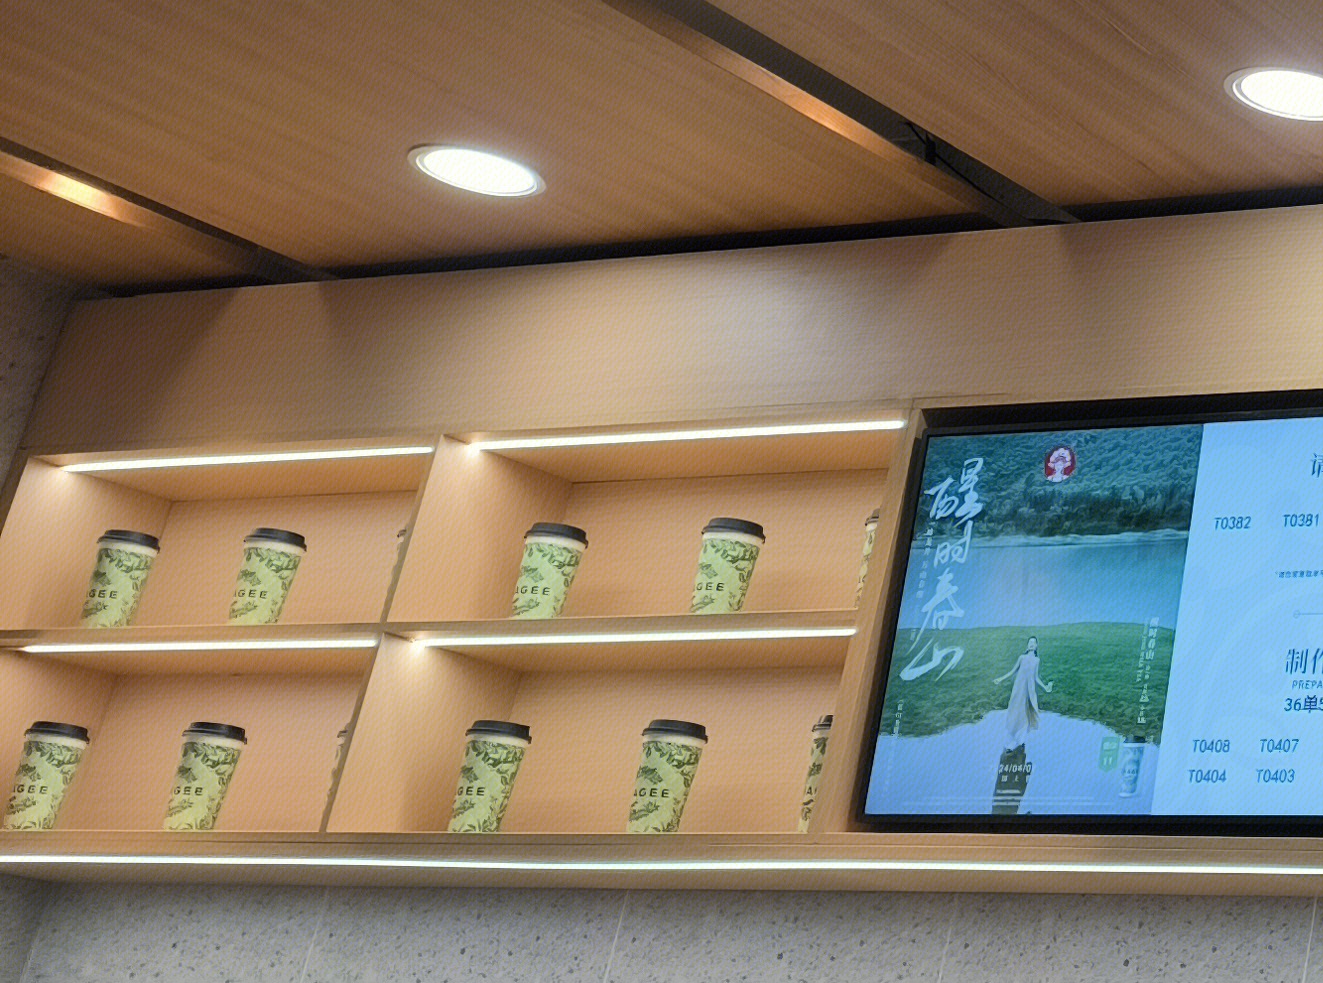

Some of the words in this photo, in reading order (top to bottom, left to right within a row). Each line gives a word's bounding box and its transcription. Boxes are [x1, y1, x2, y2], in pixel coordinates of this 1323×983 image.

[1214, 516, 1252, 531] T0382
[1283, 513, 1320, 528] T0381
[233, 588, 268, 599] GEE
[1192, 738, 1231, 754] T0408
[1259, 738, 1300, 753] T0407
[1188, 769, 1227, 784] T0404
[1256, 768, 1296, 784] T0403
[13, 783, 48, 795] GEE
